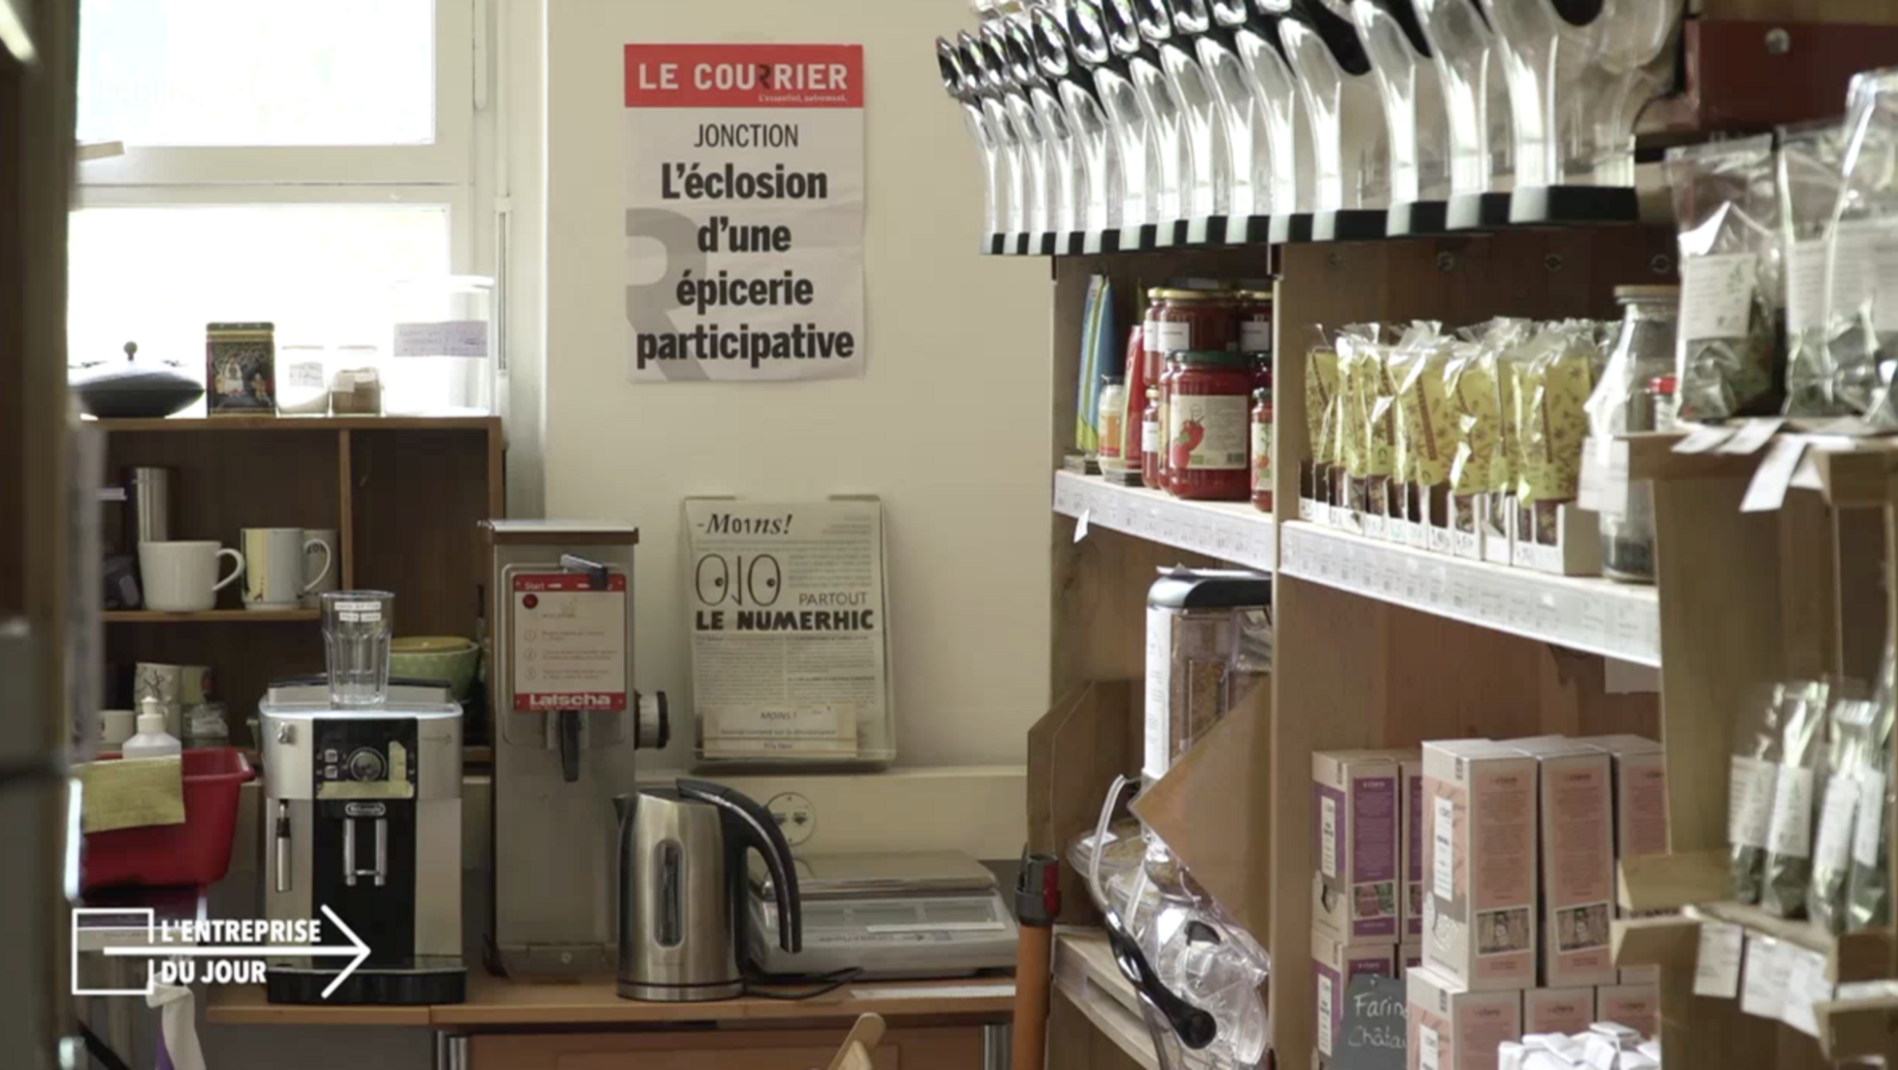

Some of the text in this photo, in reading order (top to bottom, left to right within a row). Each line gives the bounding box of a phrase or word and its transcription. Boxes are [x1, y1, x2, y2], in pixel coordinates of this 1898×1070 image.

[639, 63, 848, 90] LE COURRIER
[694, 123, 799, 148] JONCTION
[676, 269, 814, 315] épicerie
[636, 323, 855, 370] participative
[524, 582, 545, 591] Start
[799, 592, 868, 607] PARTOUT
[696, 610, 874, 631] LE NUMERHIC
